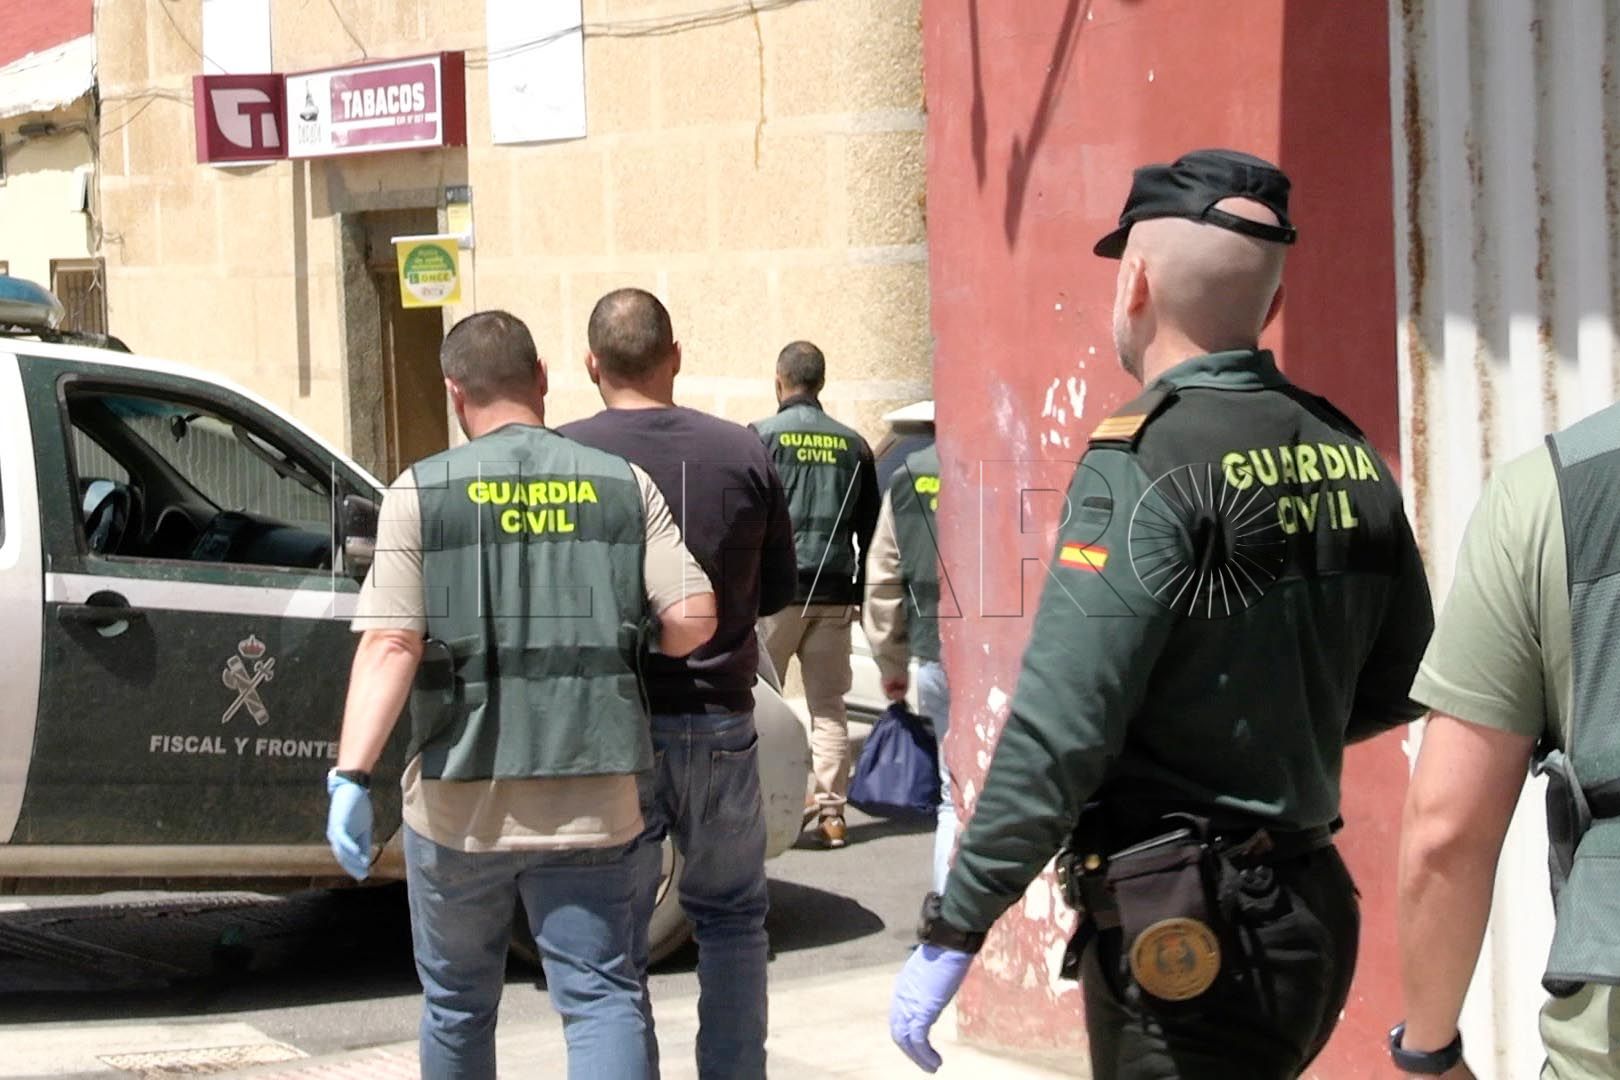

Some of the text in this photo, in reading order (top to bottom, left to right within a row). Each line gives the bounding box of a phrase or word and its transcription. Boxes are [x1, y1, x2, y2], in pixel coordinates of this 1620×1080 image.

[341, 82, 425, 119] TABACOS
[779, 433, 847, 450] GUARDIA
[797, 448, 837, 464] CIVIL
[1221, 443, 1379, 489] GUARDIA
[467, 480, 597, 506] GUARDIA
[501, 509, 574, 534] CIVIL
[1277, 489, 1358, 534] CIVIL
[150, 735, 339, 759] FISCAL Y FRONTE
